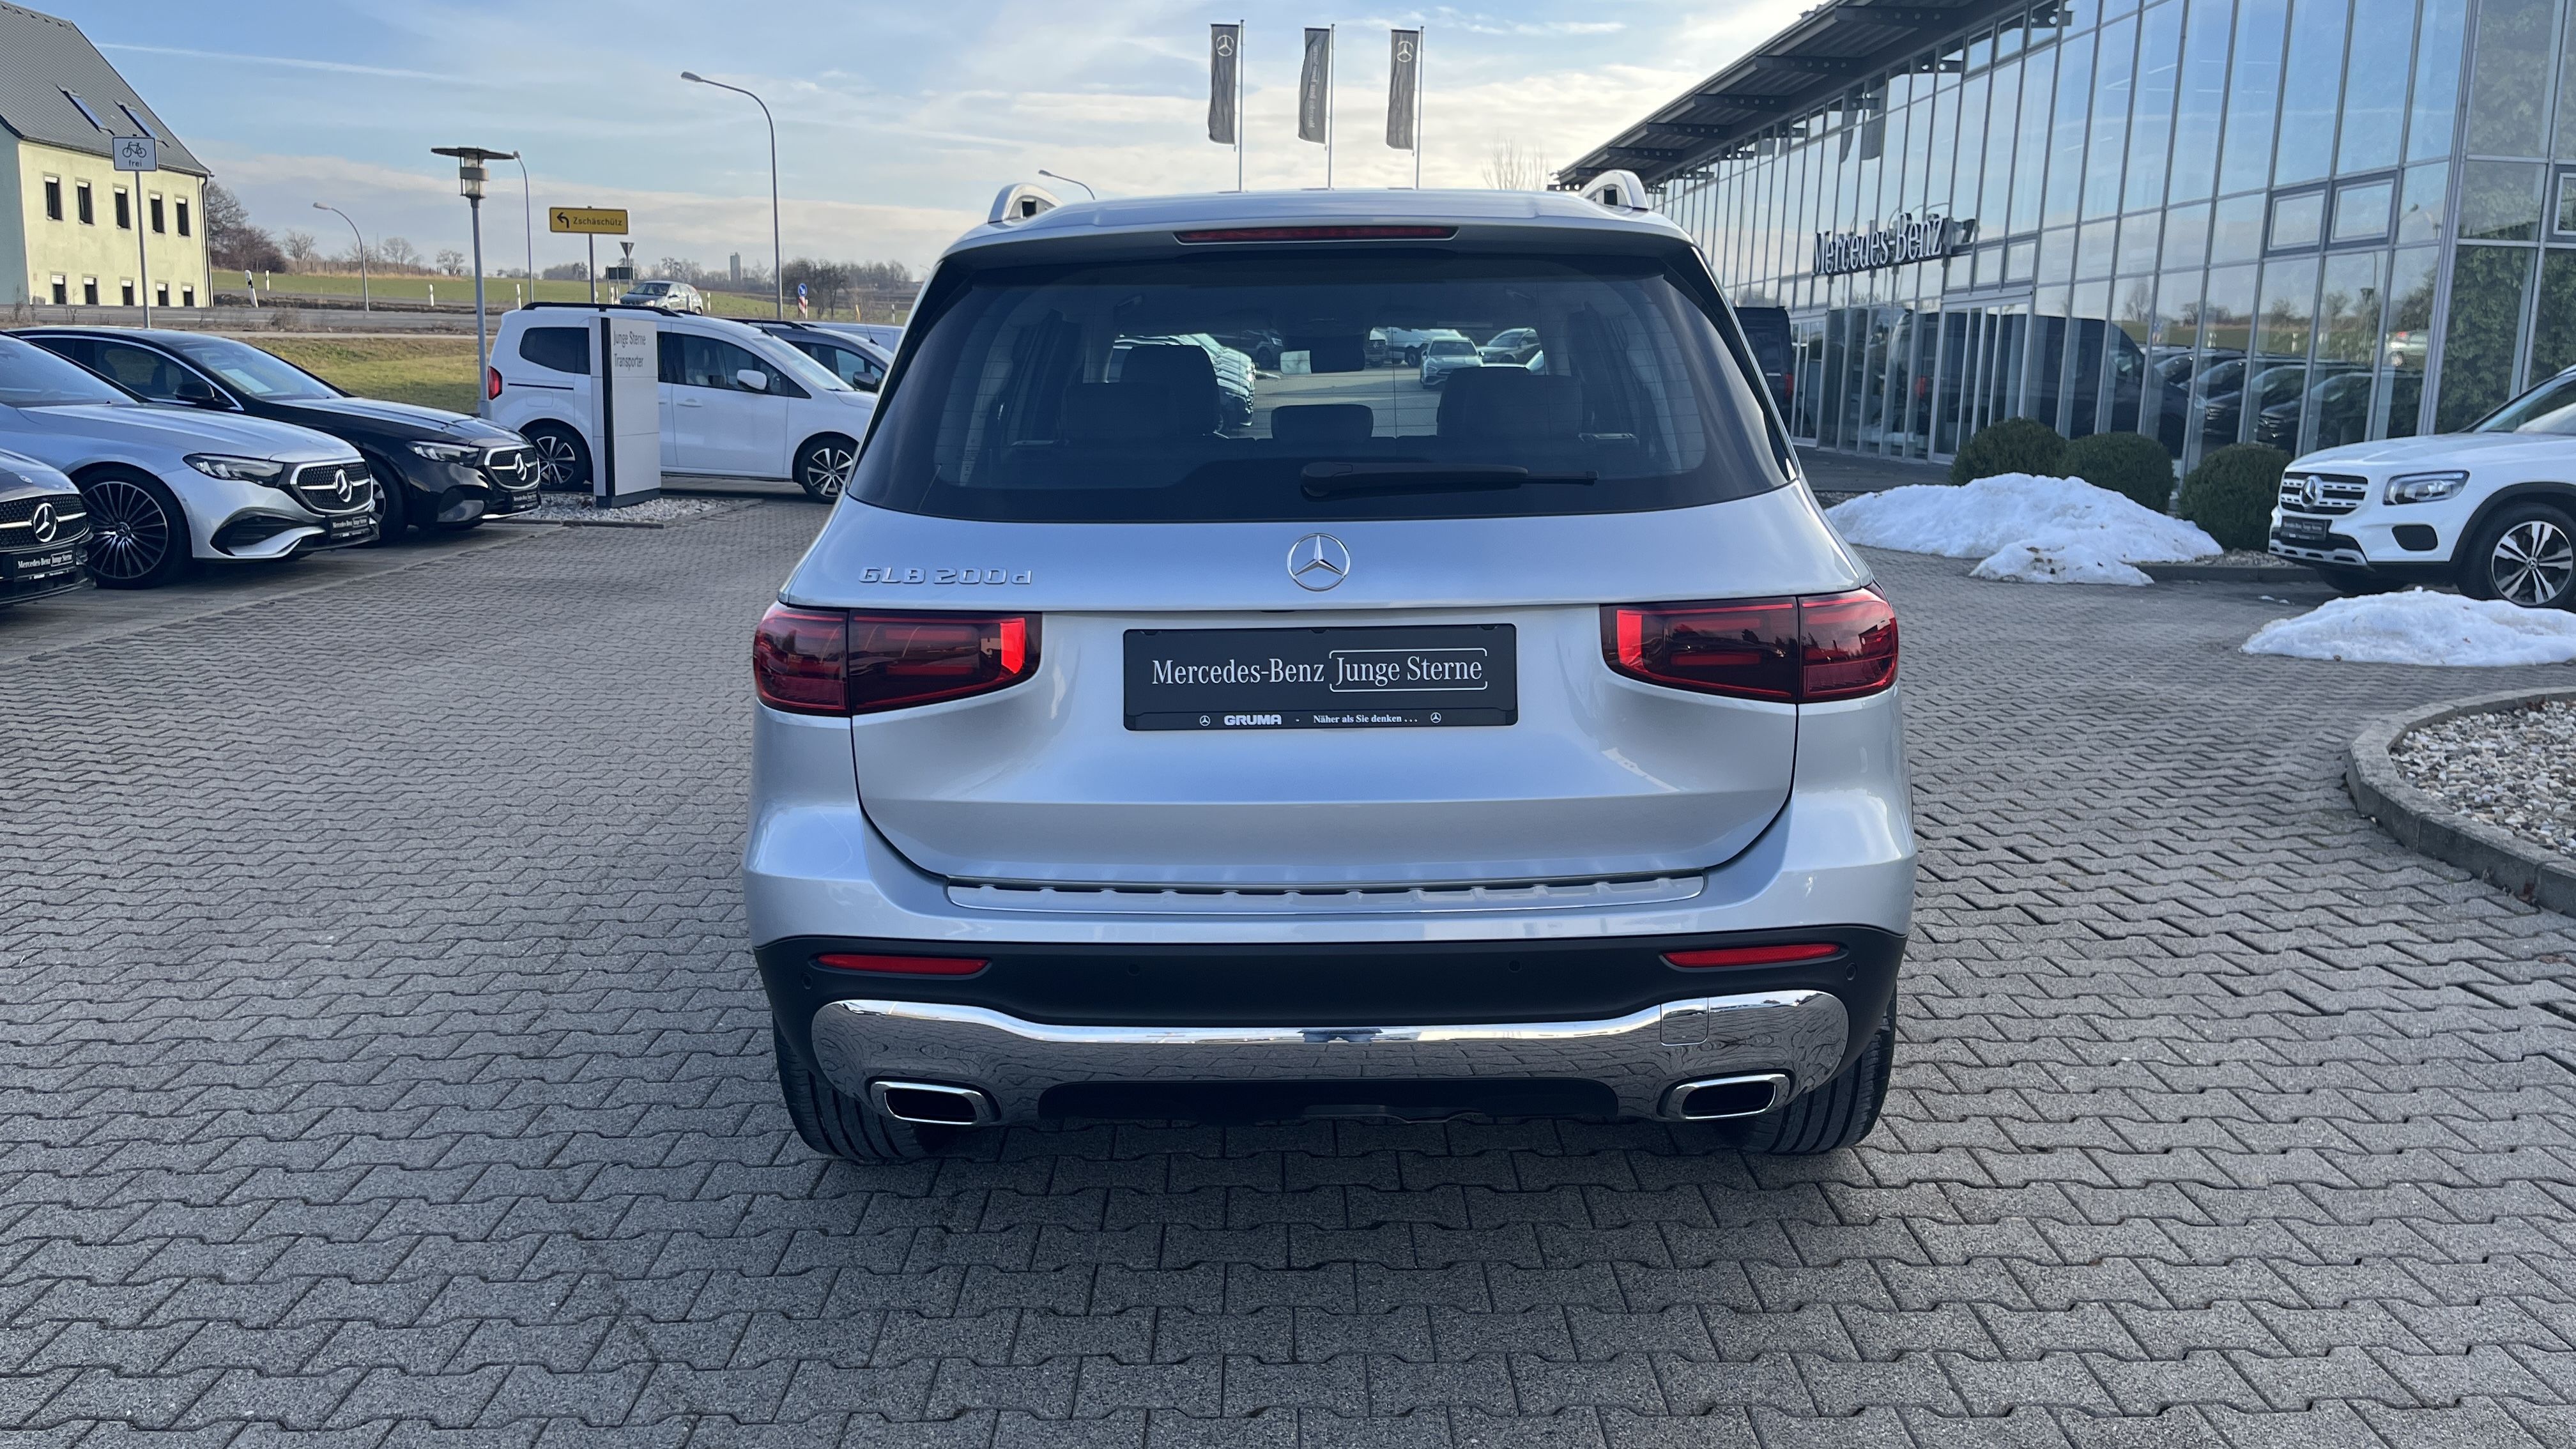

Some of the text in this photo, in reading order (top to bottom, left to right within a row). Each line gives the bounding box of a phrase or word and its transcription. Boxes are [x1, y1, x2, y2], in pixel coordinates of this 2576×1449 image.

[128, 159, 142, 167] frei
[573, 217, 622, 226] Zschäschütz
[1813, 212, 1943, 275] Mercedes-Benz
[613, 331, 647, 348] Junge Sterne
[614, 353, 644, 371] Transporter
[859, 567, 926, 584] GLB
[1151, 656, 1482, 687] Mercedes-Benz Junge Sterne
[1224, 714, 1282, 726] GRUMA
[1313, 714, 1340, 723] Näher
[1342, 714, 1354, 723] als
[1356, 714, 1369, 723] Sie
[1371, 714, 1402, 723] denken
